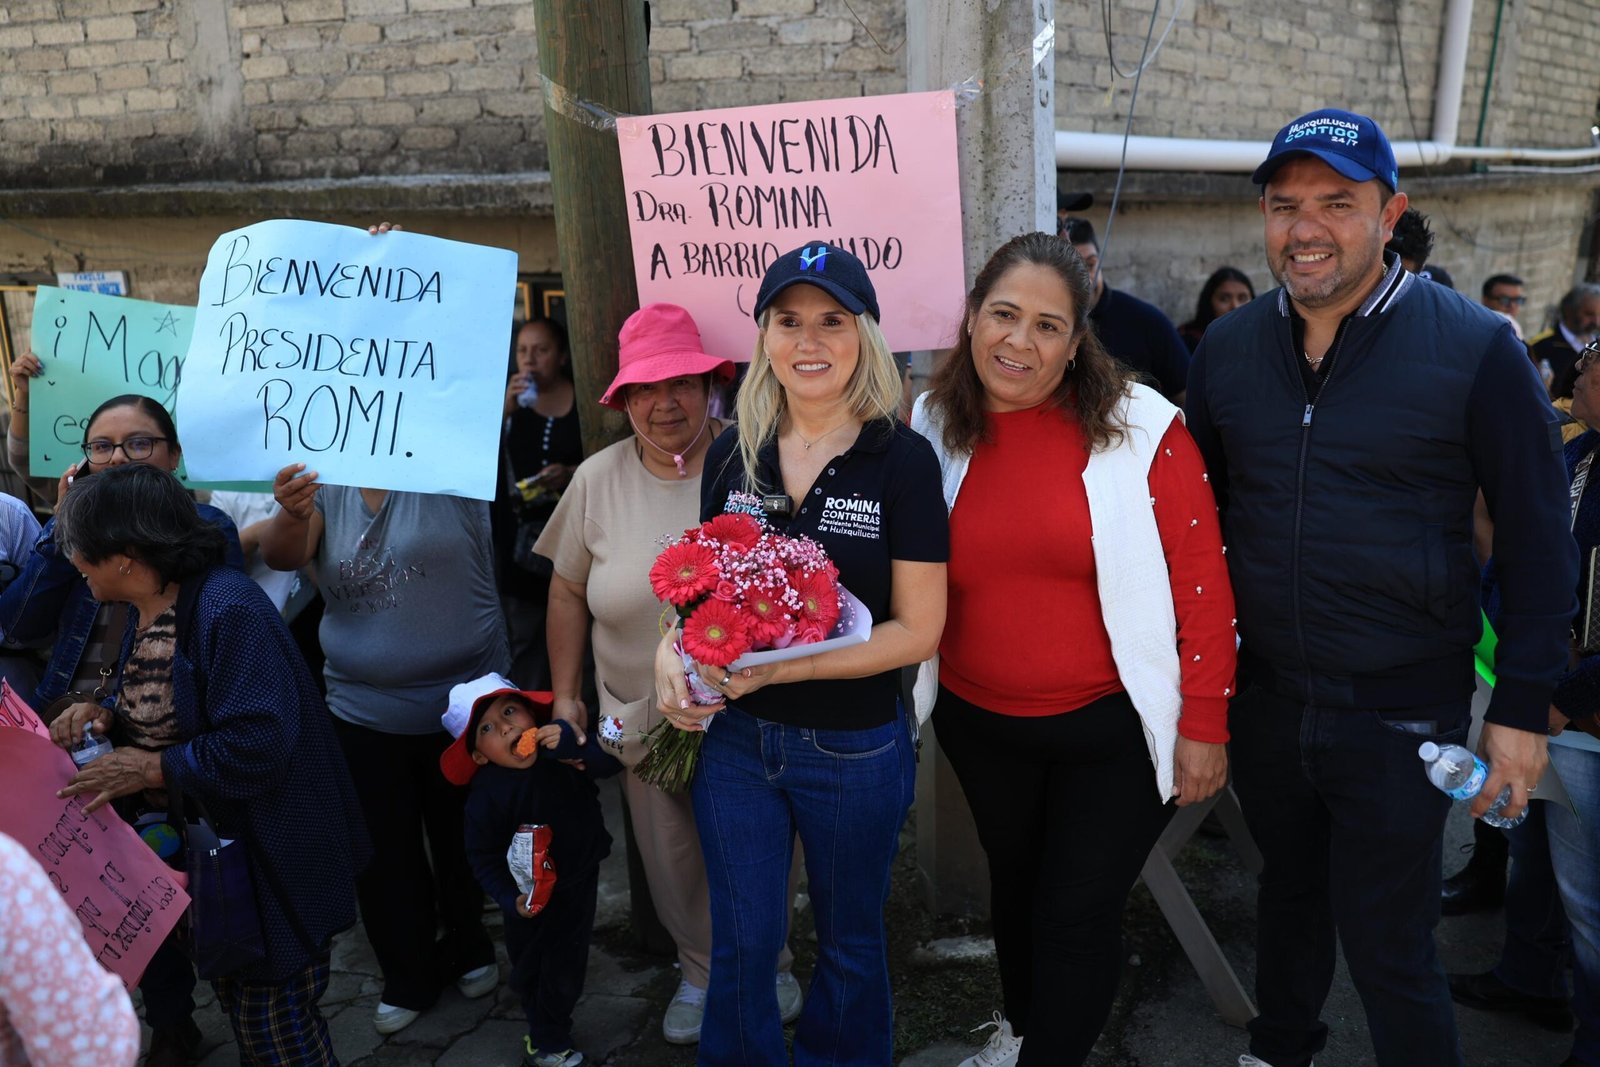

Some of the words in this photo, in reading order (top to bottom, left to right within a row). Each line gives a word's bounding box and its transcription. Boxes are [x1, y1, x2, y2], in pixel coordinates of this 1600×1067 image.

[648, 114, 899, 178] BIENVENIDA
[1285, 126, 1358, 143] CONTIGO
[1331, 135, 1358, 146] 24/7
[699, 181, 832, 230] ROMINA
[211, 234, 442, 307] BIENVENIDA
[650, 243, 672, 281] A
[220, 311, 436, 380] PRESIDENTA
[256, 378, 414, 458] ROMI.
[822, 509, 880, 525] CONTRERAS
[825, 497, 880, 515] ROMINA
[817, 524, 828, 532] de
[829, 525, 880, 539] Huixquilucan
